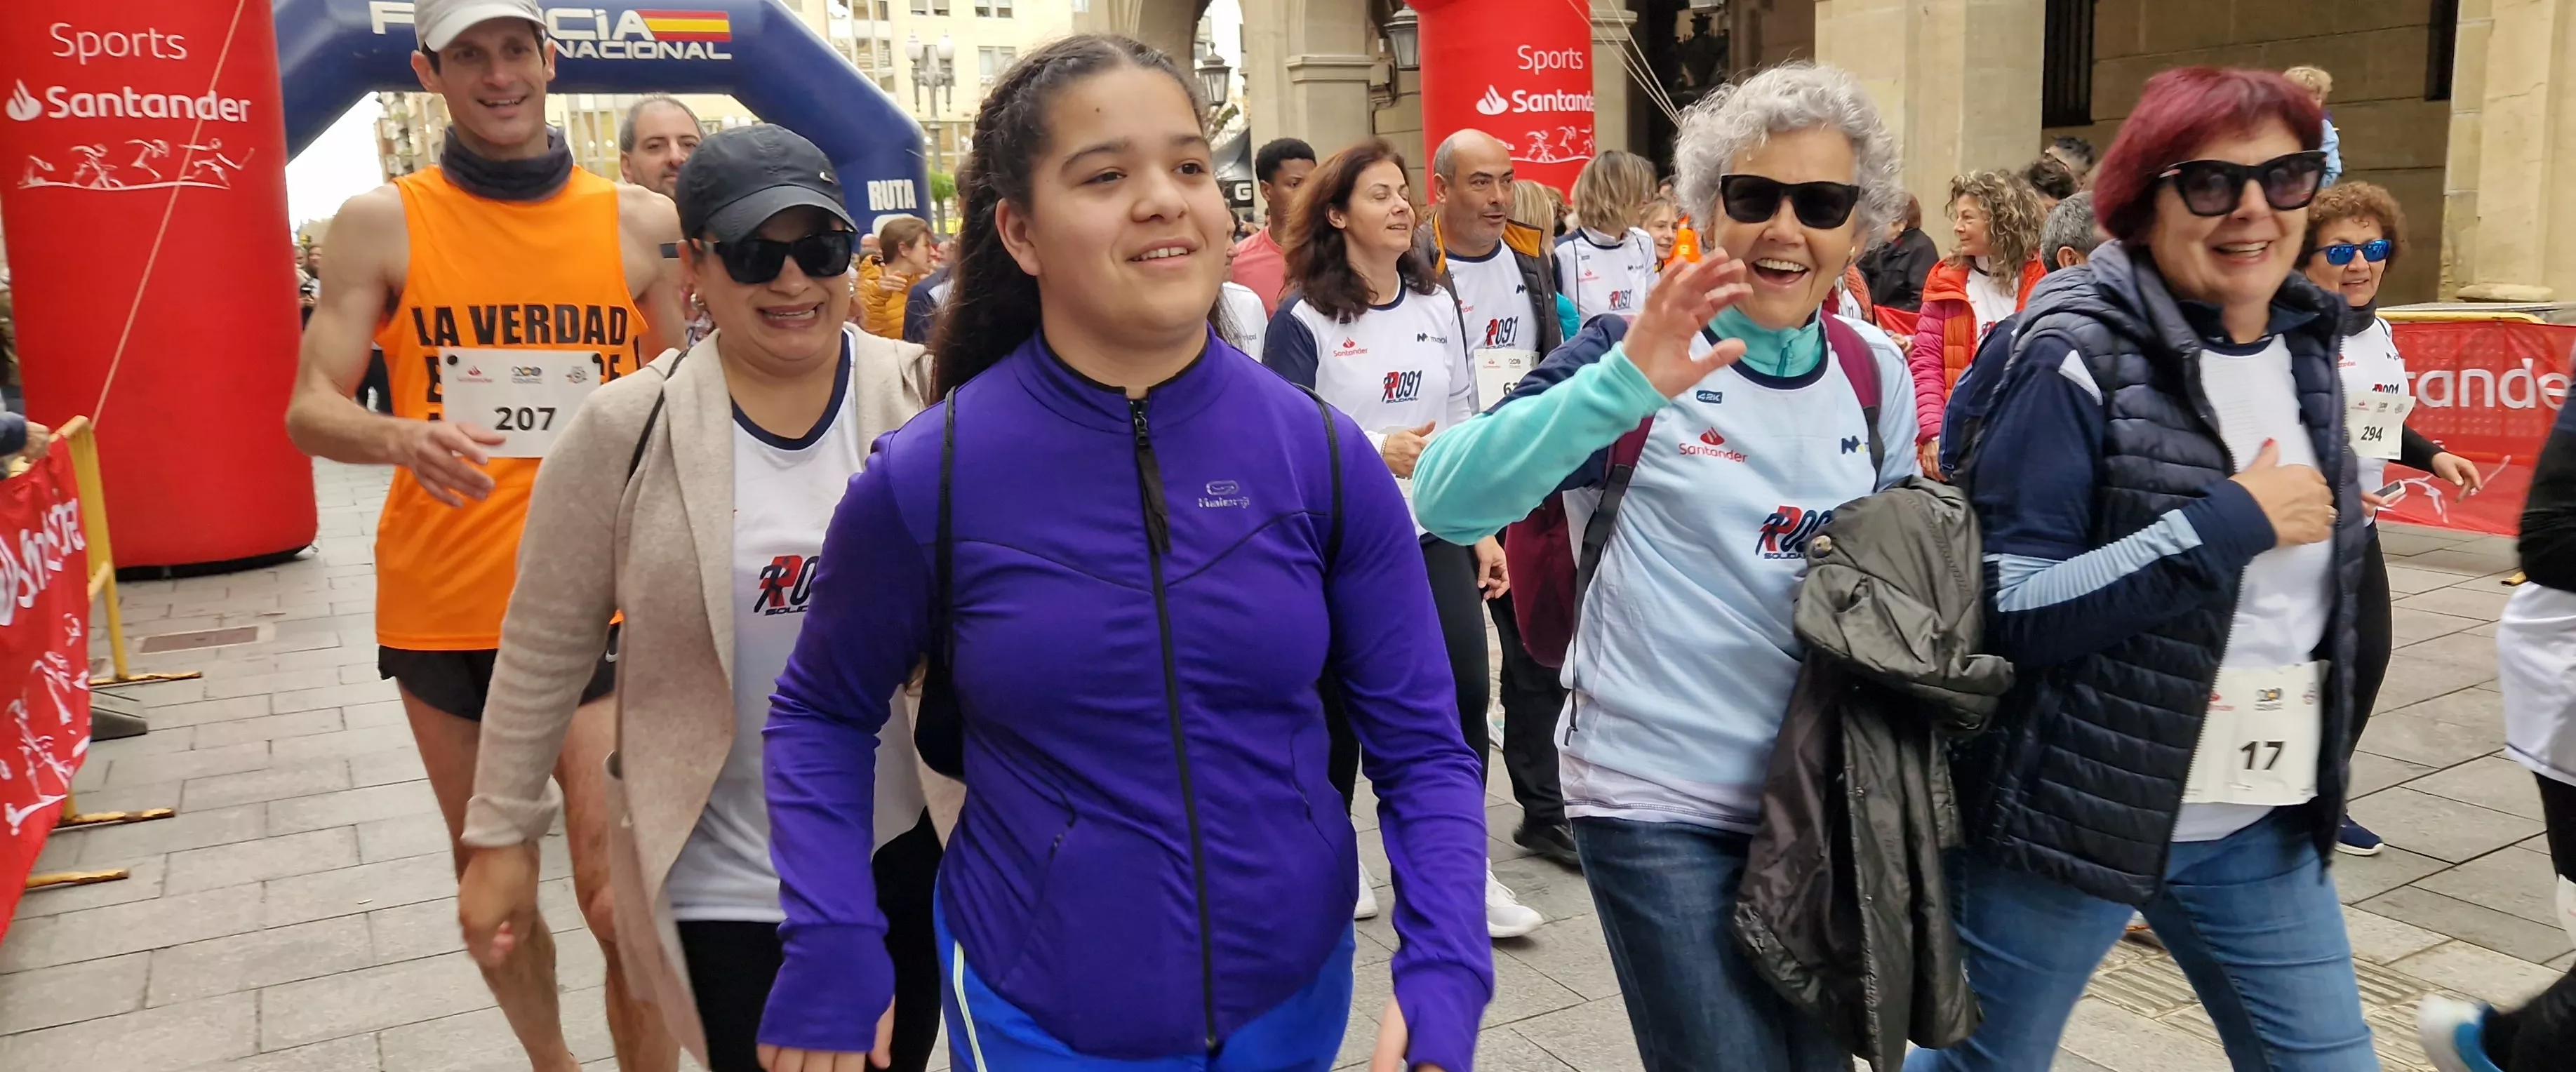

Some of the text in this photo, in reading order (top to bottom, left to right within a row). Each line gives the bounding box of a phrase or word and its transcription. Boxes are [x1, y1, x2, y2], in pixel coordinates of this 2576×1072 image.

[50, 22, 187, 65] Sports
[1517, 44, 1583, 75] Sports
[45, 86, 251, 121] Santander
[1511, 88, 1595, 113] Santande
[867, 179, 917, 210] RUTA
[411, 304, 628, 347] LA VERDAD
[1333, 348, 1368, 357] Santander
[493, 406, 556, 431] 207
[2361, 425, 2384, 442] 294
[1679, 443, 1747, 463] Santander
[2240, 740, 2285, 771] 17
